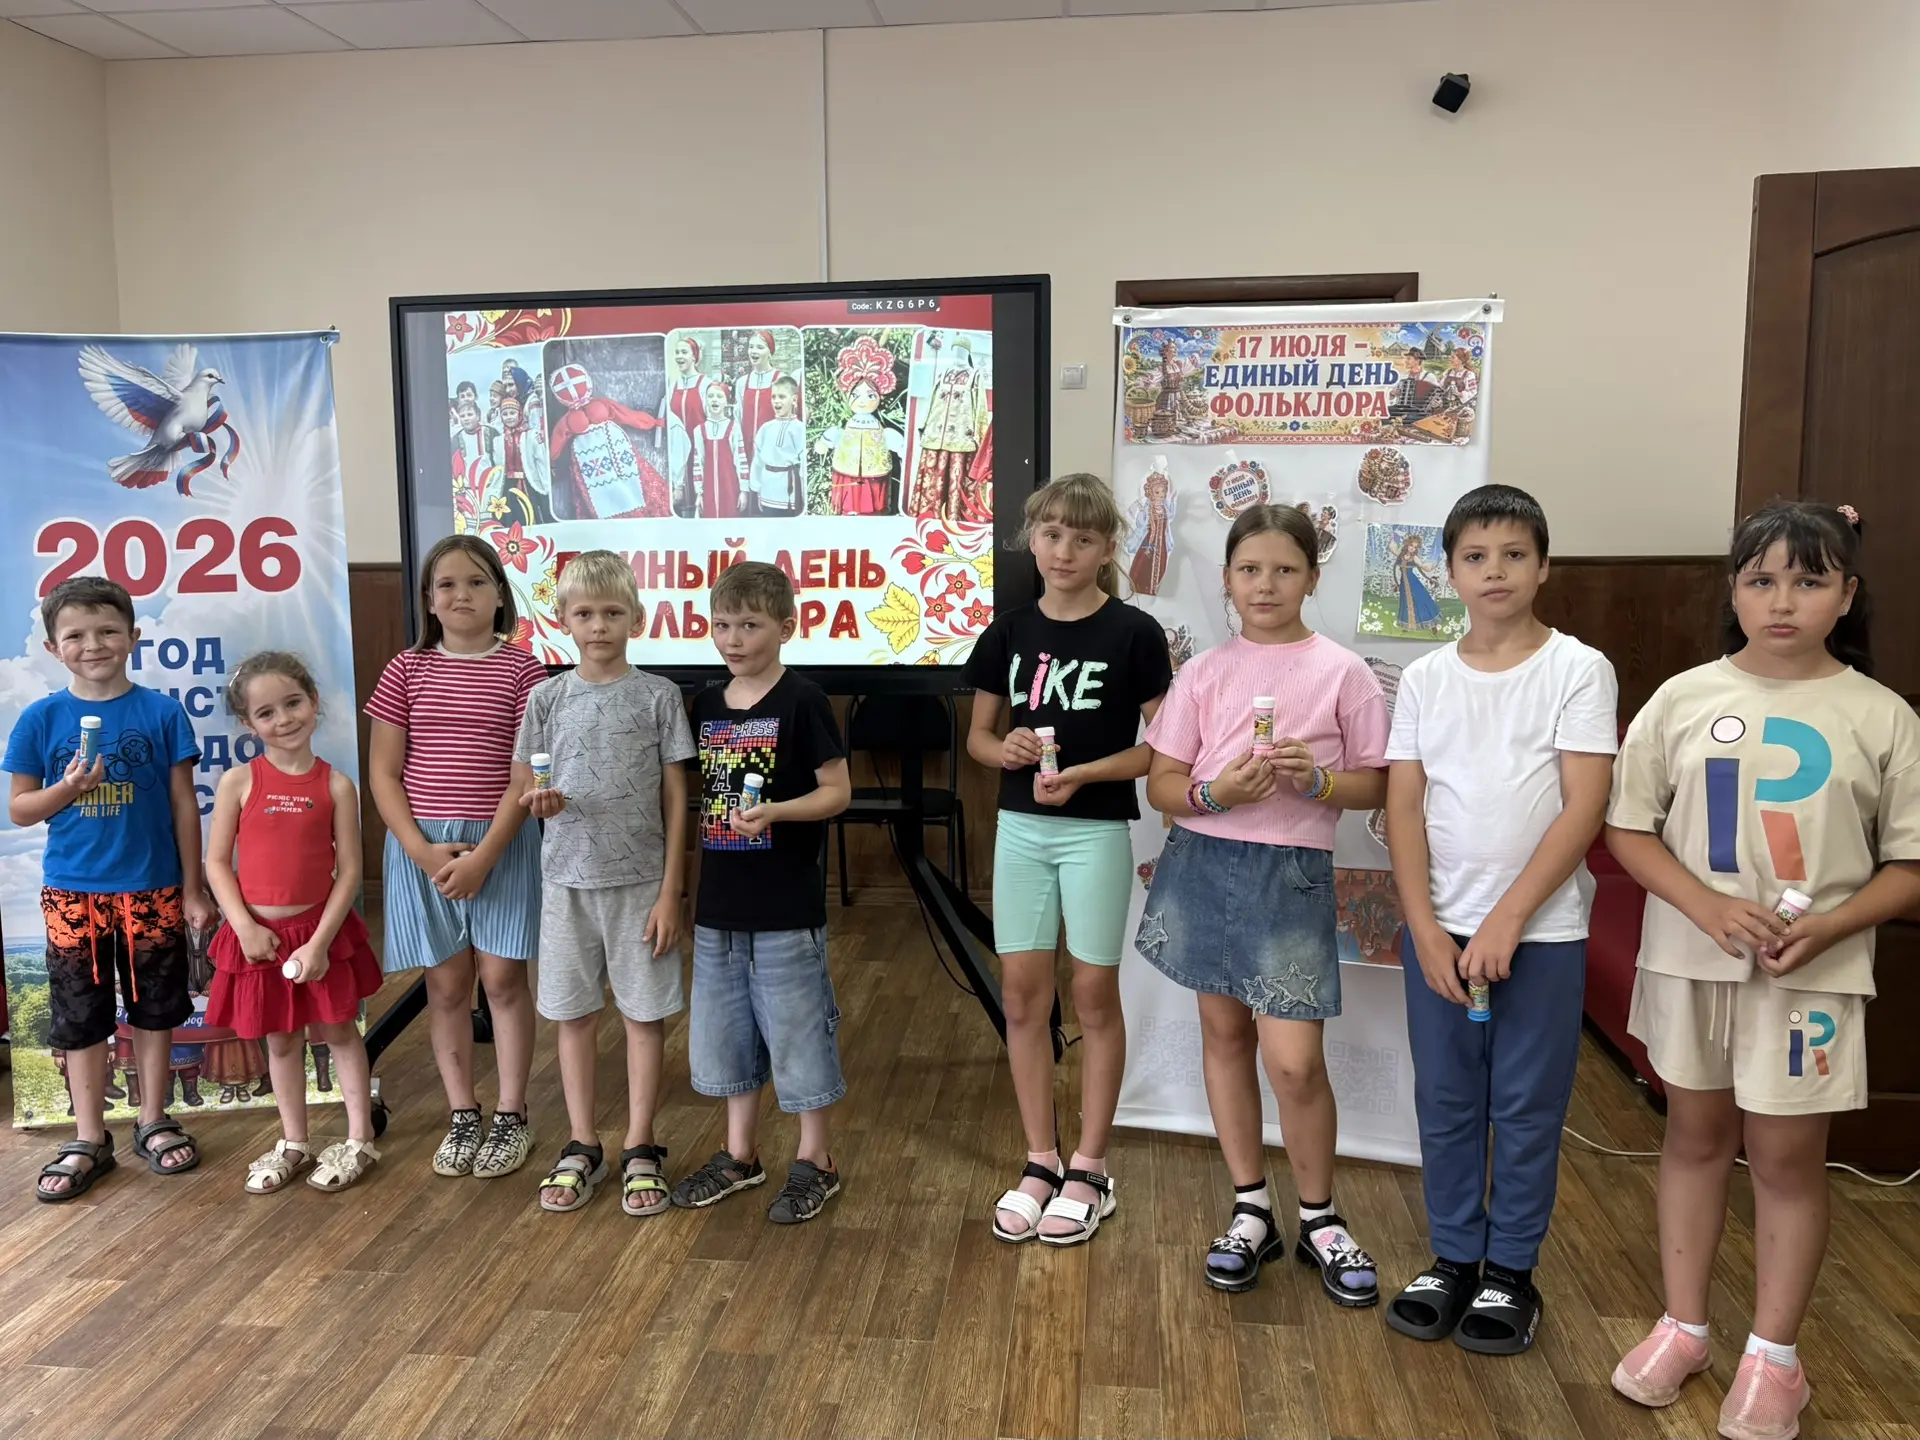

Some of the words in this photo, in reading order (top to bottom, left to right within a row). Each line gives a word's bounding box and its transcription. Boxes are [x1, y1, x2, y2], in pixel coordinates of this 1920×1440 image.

[1236, 336, 1262, 358] 17
[1269, 335, 1346, 358] ИЮЛЯ
[1204, 359, 1319, 389] ЕДИНЫЙ
[1326, 363, 1399, 389] ДЕНЬ
[1210, 391, 1388, 417] ФОЛЬКЛОРА
[1223, 477, 1256, 497] ЕДИНЫЙ
[1232, 488, 1253, 502] ДЕНЬ
[37, 516, 301, 597] 2026
[774, 549, 886, 596] ДЕНЬ
[733, 721, 776, 738] PRESS
[80, 806, 98, 818] FOR
[101, 805, 120, 816] LIFE
[1414, 1275, 1444, 1287] NIKE
[1479, 1288, 1514, 1304] NIKE
